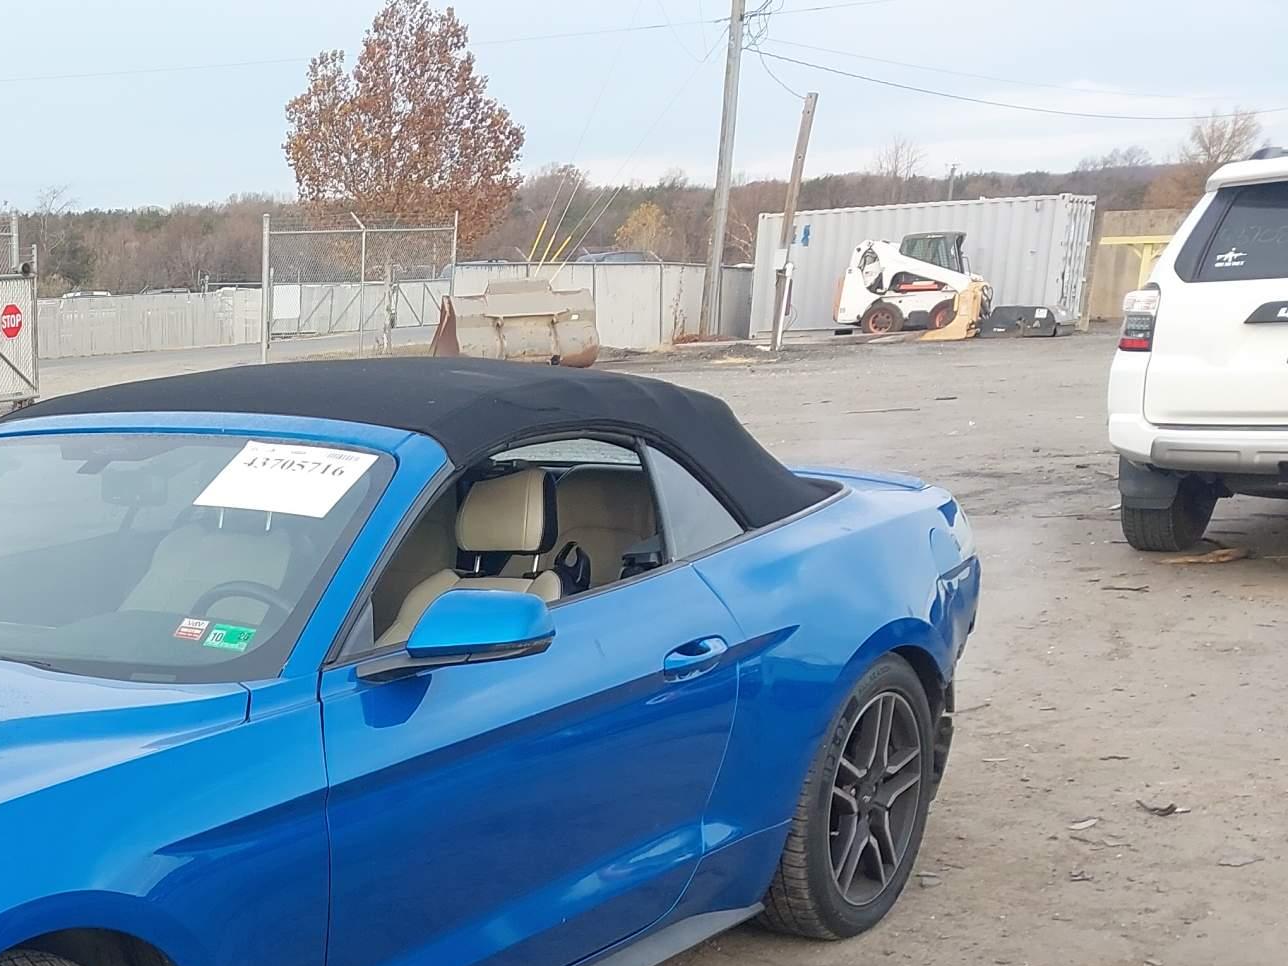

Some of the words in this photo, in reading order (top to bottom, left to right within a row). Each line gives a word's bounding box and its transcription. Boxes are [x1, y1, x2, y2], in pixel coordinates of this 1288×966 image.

[2, 313, 22, 329] STOP
[243, 456, 345, 477] 43705716
[211, 631, 224, 642] 10
